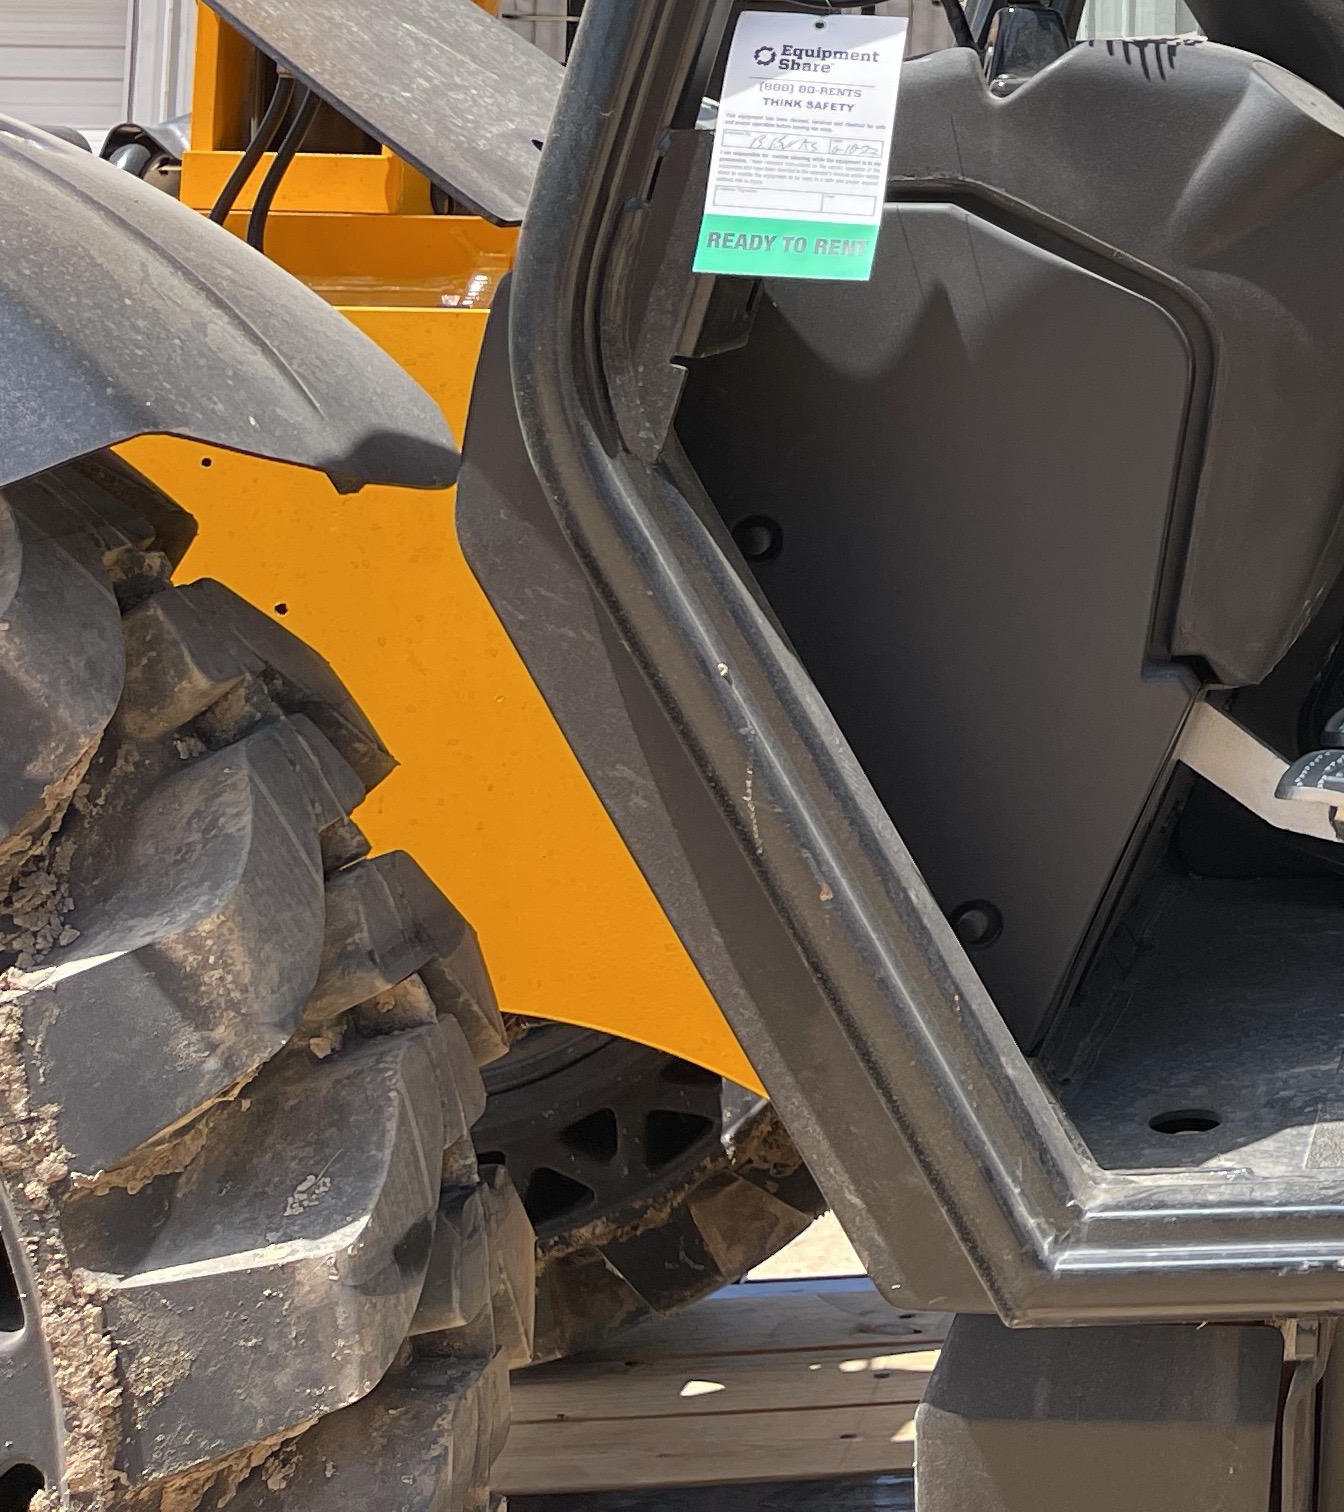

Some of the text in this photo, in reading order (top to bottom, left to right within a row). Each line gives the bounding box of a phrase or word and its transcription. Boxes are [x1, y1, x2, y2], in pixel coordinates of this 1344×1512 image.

[780, 44, 880, 63] Equipment
[778, 58, 831, 74] Share
[762, 97, 856, 113] THINK SAFETY
[706, 231, 868, 257] READY TO RENT
